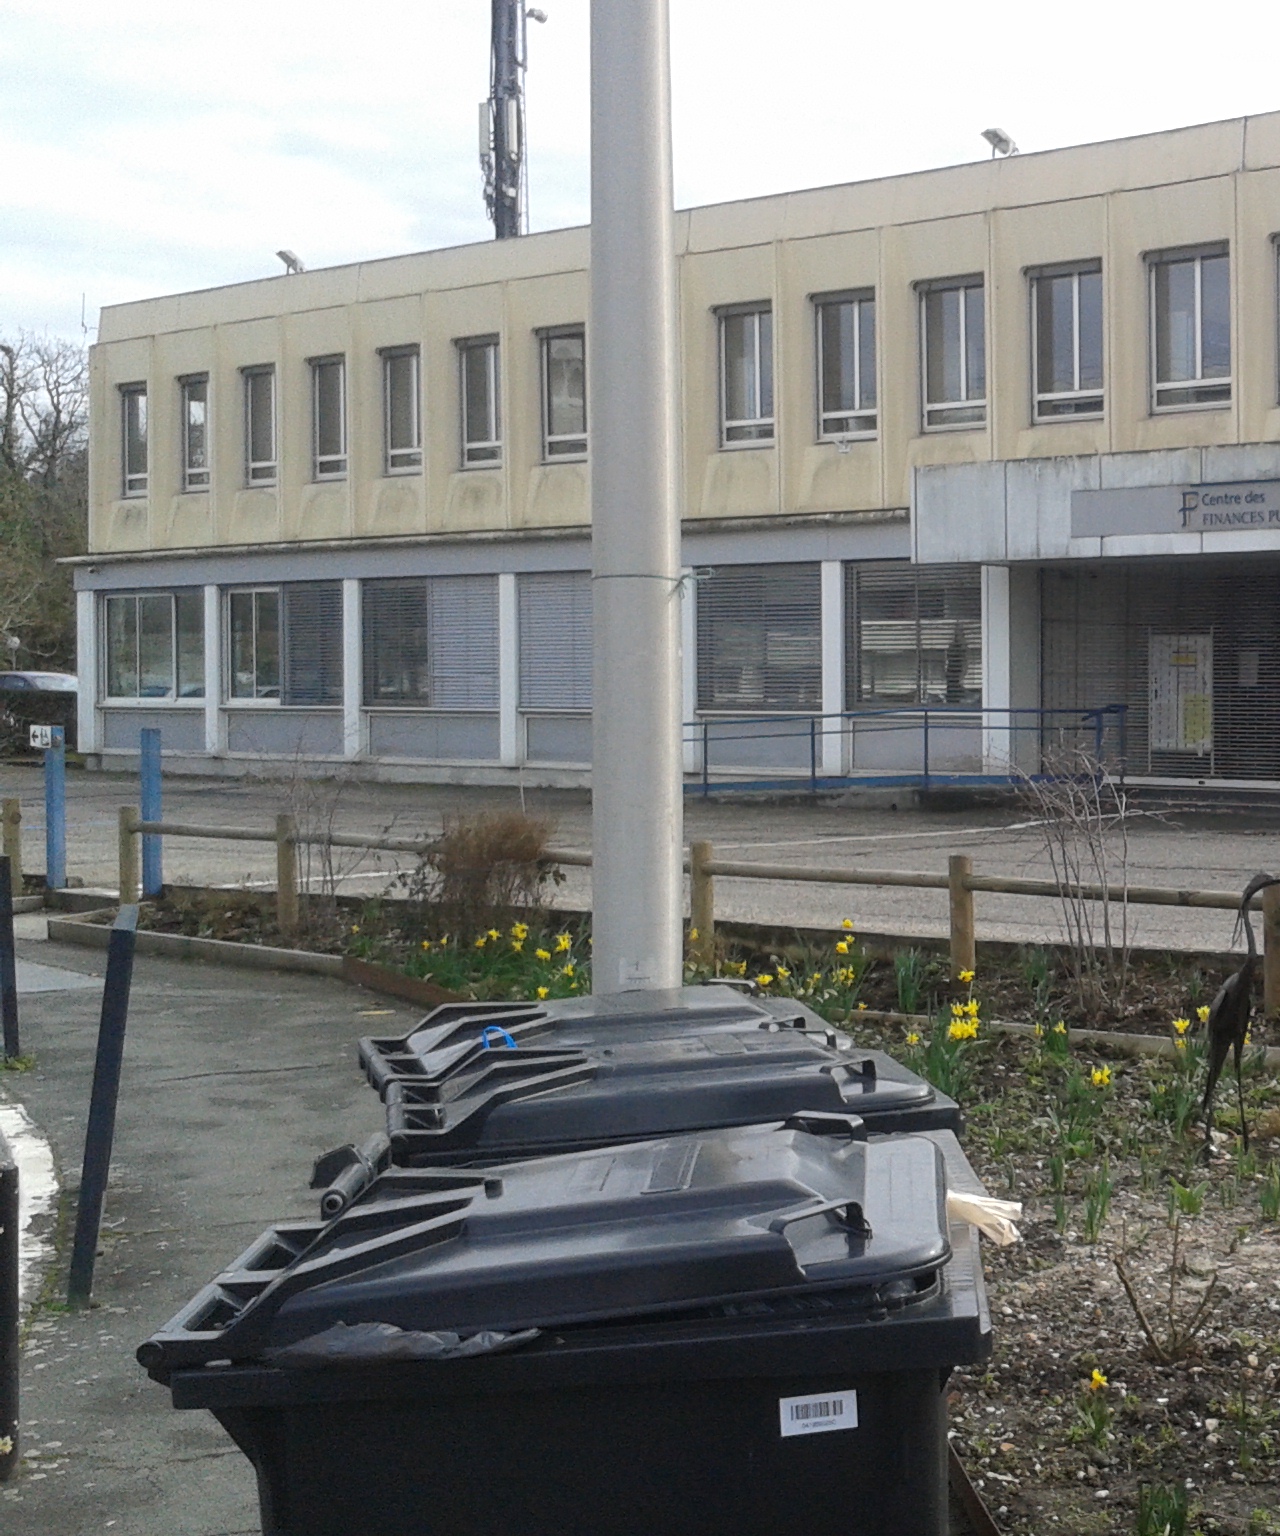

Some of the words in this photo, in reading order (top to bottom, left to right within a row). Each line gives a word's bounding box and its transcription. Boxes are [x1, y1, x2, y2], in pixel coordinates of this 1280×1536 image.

[1201, 493, 1241, 507] Centre
[1244, 490, 1265, 504] des
[1202, 511, 1265, 526] FINANCES
